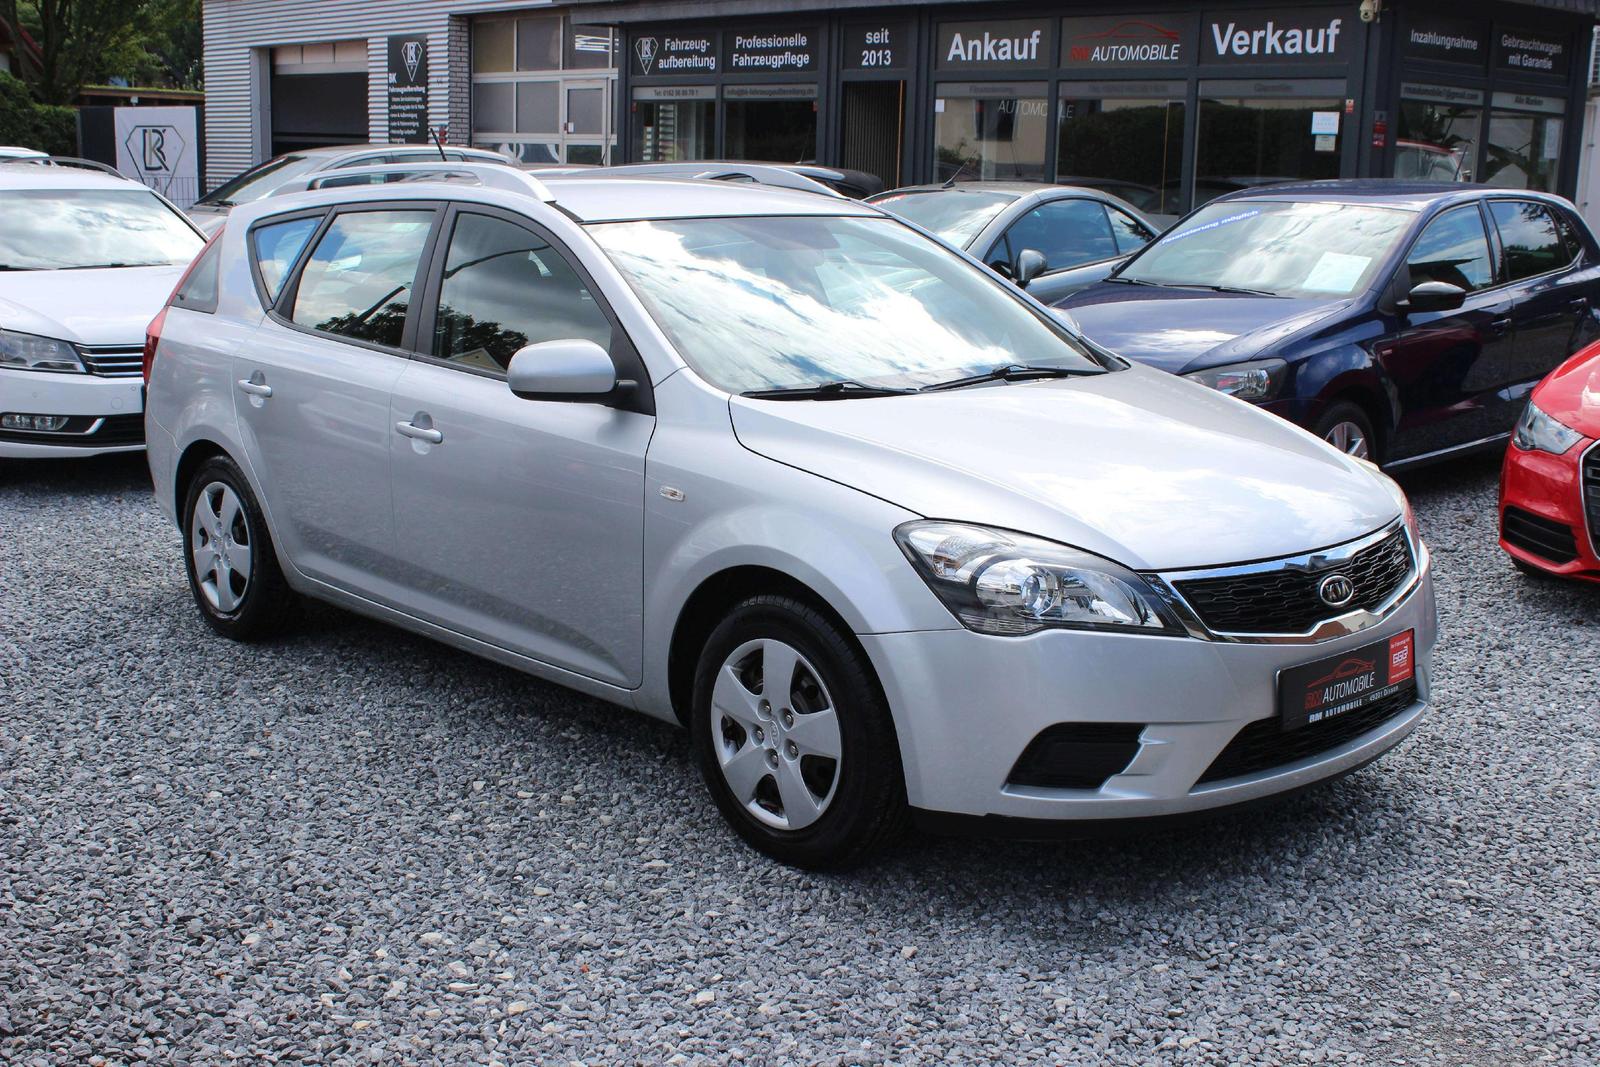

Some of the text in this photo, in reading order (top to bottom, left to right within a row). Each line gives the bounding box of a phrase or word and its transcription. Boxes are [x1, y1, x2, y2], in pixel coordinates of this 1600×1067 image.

[735, 33, 807, 49] Professionelle
[865, 28, 889, 44] seit
[1211, 19, 1341, 55] Verkauf
[1410, 29, 1478, 51] Inzahlungnahme
[664, 38, 711, 53] Fahrzeug-
[947, 30, 1040, 62] Ankauf
[1091, 44, 1181, 62] AUTOMOBILE
[1501, 34, 1562, 56] Gebrauchtwagen
[658, 55, 716, 70] aufbereitung
[732, 51, 810, 68] Fahrzeugpflege
[861, 50, 892, 66] 2013
[1508, 54, 1553, 70] mit Garantie
[1322, 671, 1376, 704] AUTOMOBILE
[1325, 698, 1363, 718] AUTOMOBILE
